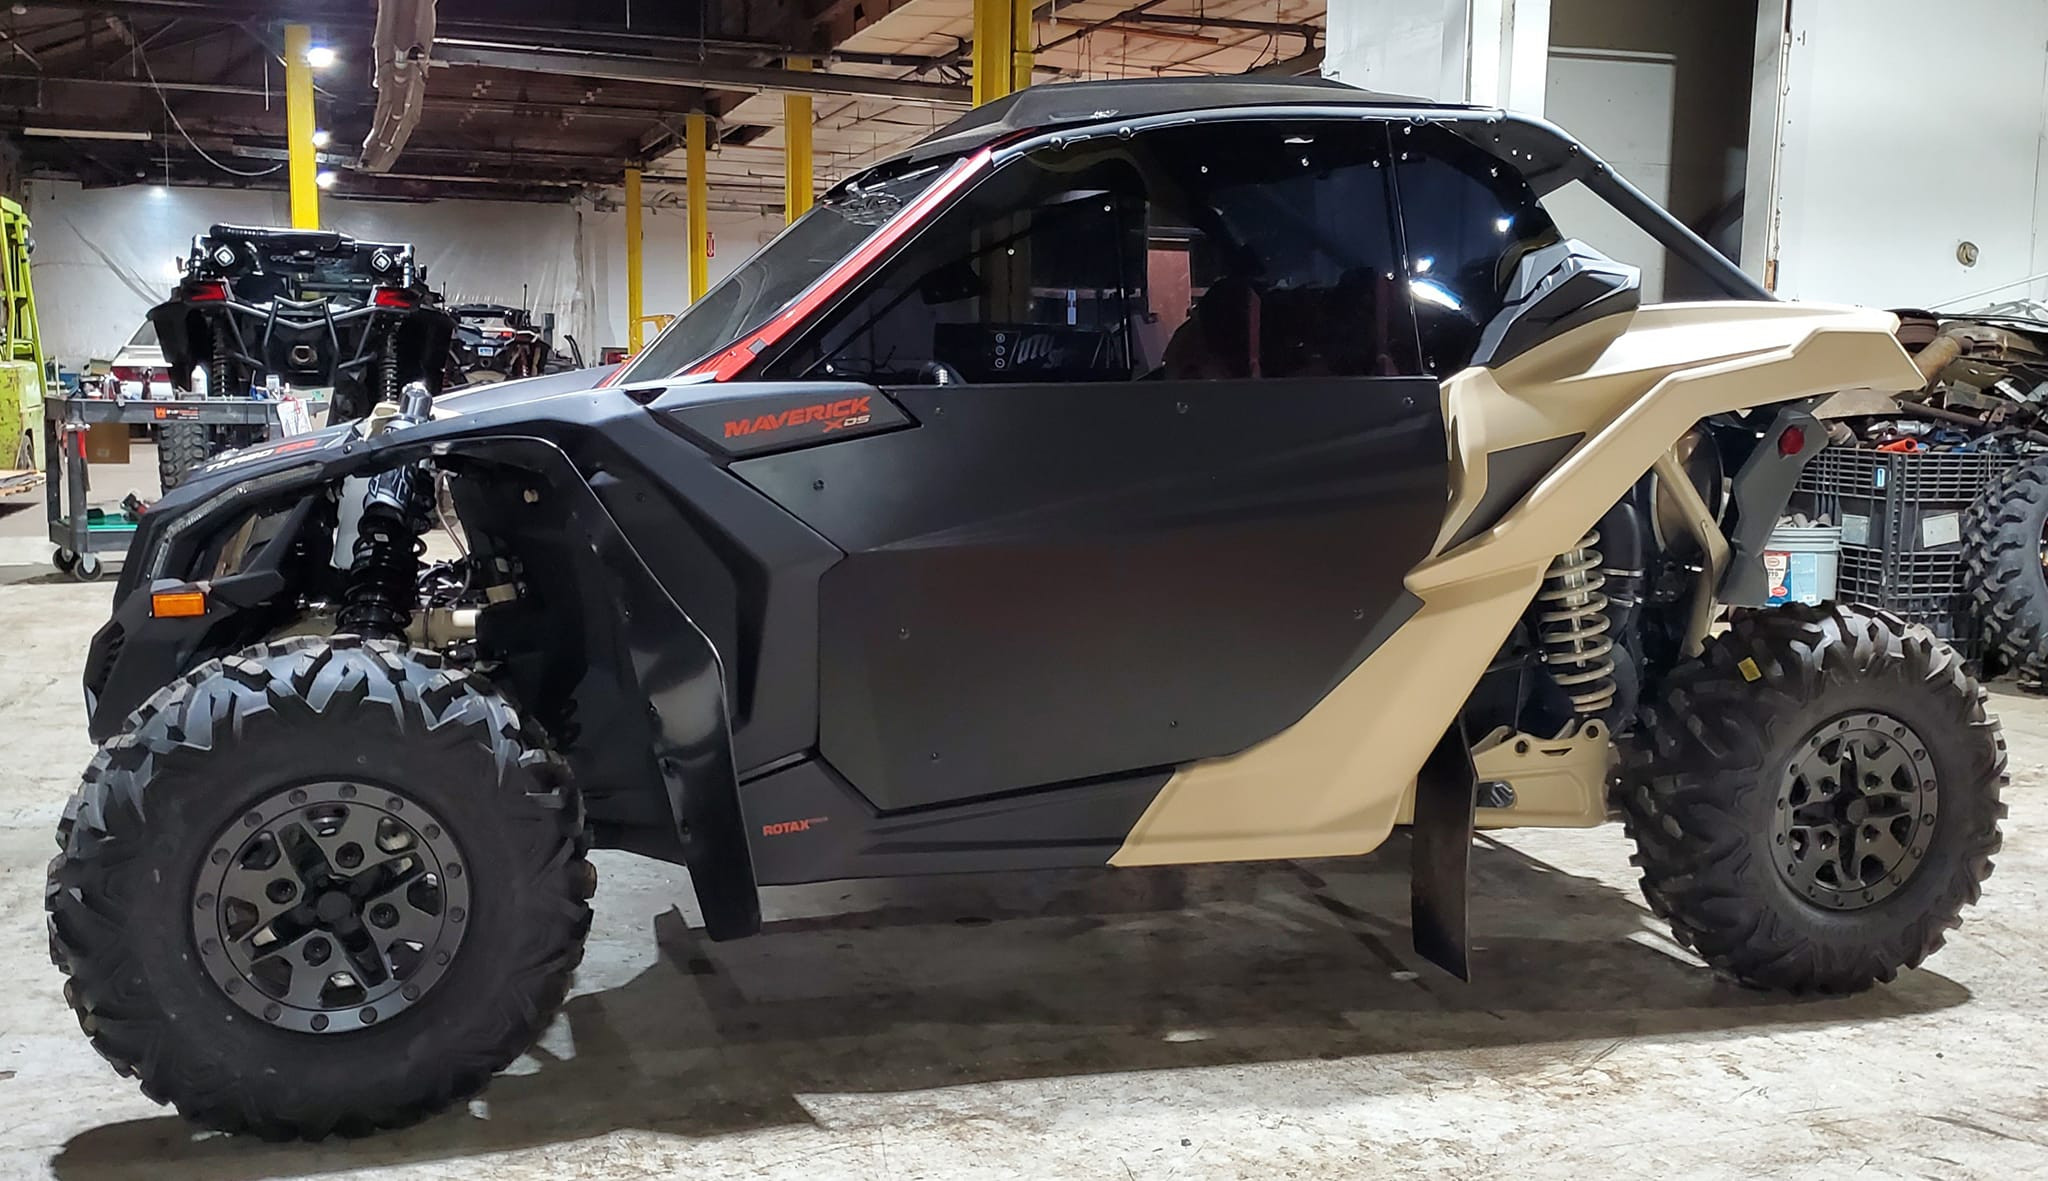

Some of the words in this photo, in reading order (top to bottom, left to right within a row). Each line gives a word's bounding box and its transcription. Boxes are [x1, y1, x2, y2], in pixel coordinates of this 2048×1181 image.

[723, 395, 871, 439] MAVERICK
[823, 414, 871, 433] XDS
[205, 448, 275, 473] TURBO
[762, 819, 810, 837] ROTAX
